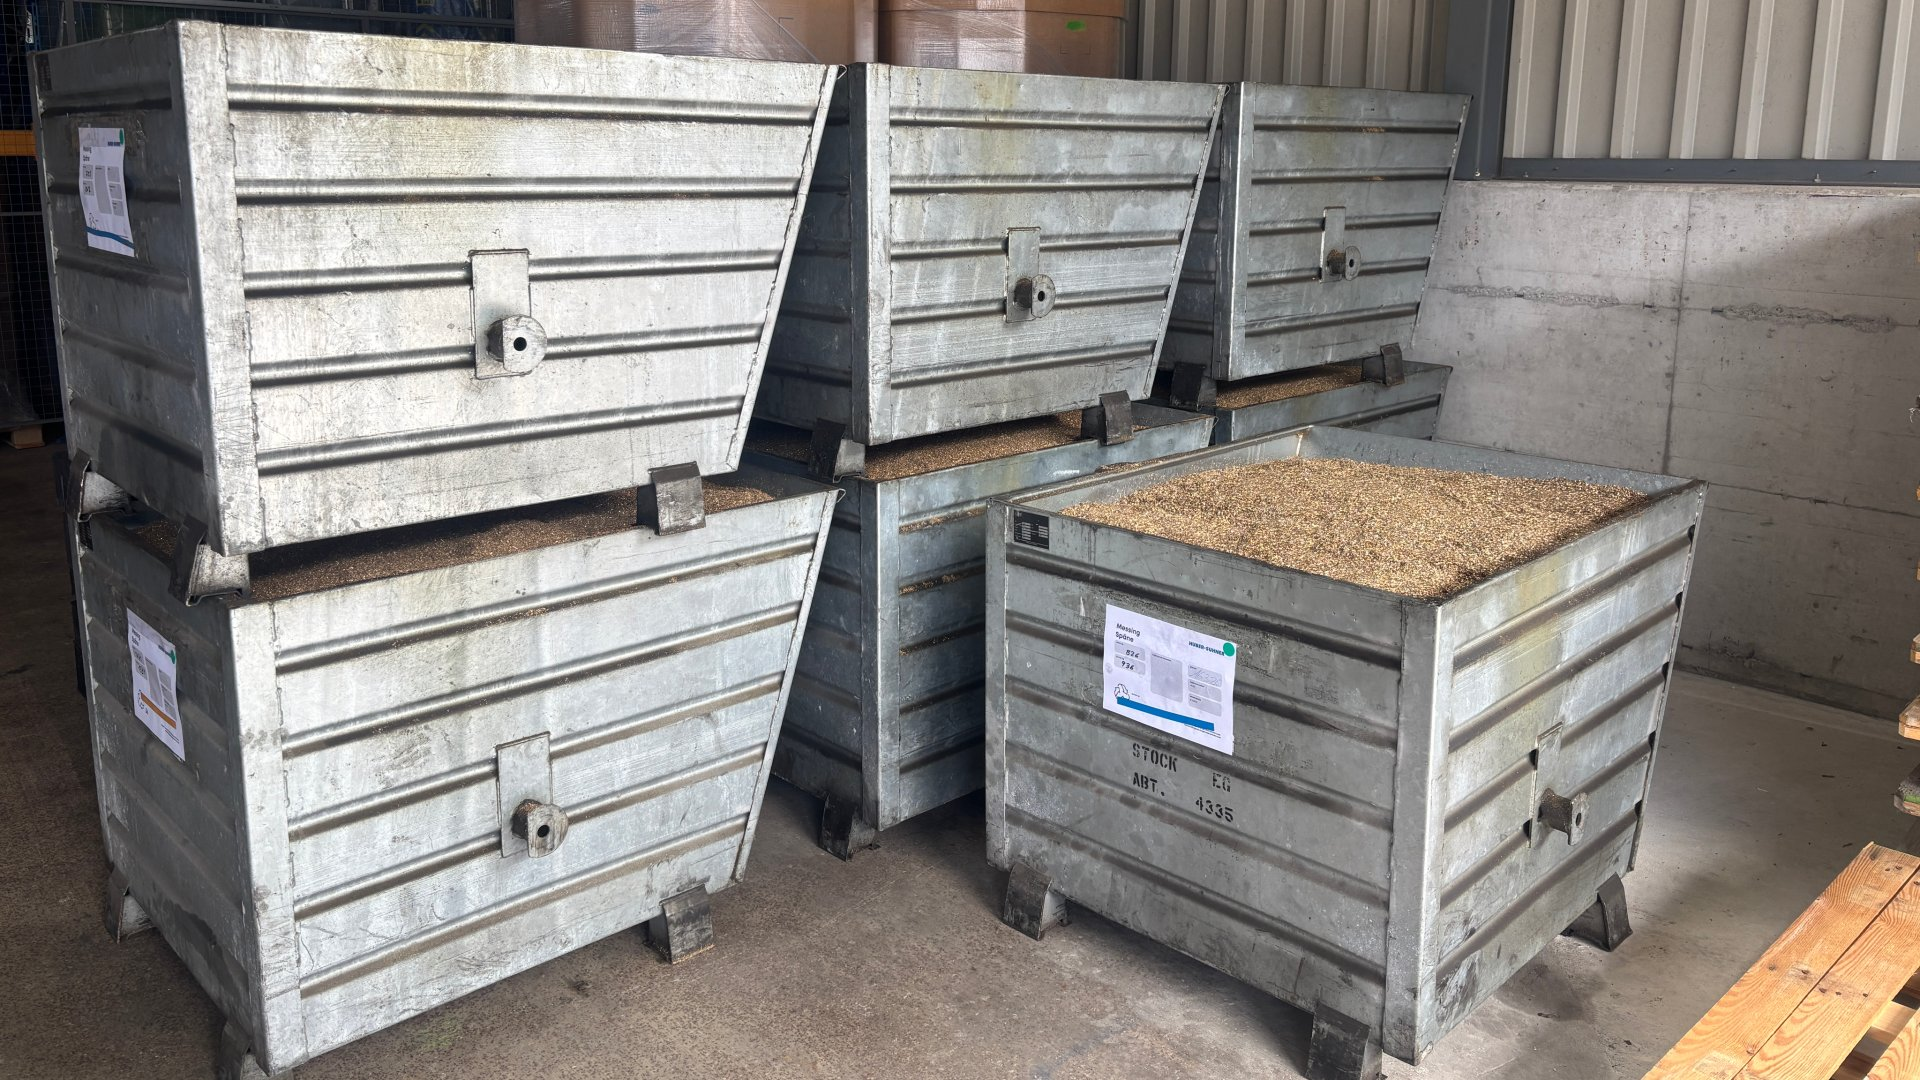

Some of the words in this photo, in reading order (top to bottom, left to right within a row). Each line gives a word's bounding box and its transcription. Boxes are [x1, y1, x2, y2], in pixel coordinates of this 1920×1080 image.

[1116, 623, 1140, 637] Messing
[1132, 743, 1178, 772] STOCK
[1212, 772, 1231, 792] EG
[1132, 772, 1165, 796] ABT.
[1195, 796, 1234, 822] 4335
